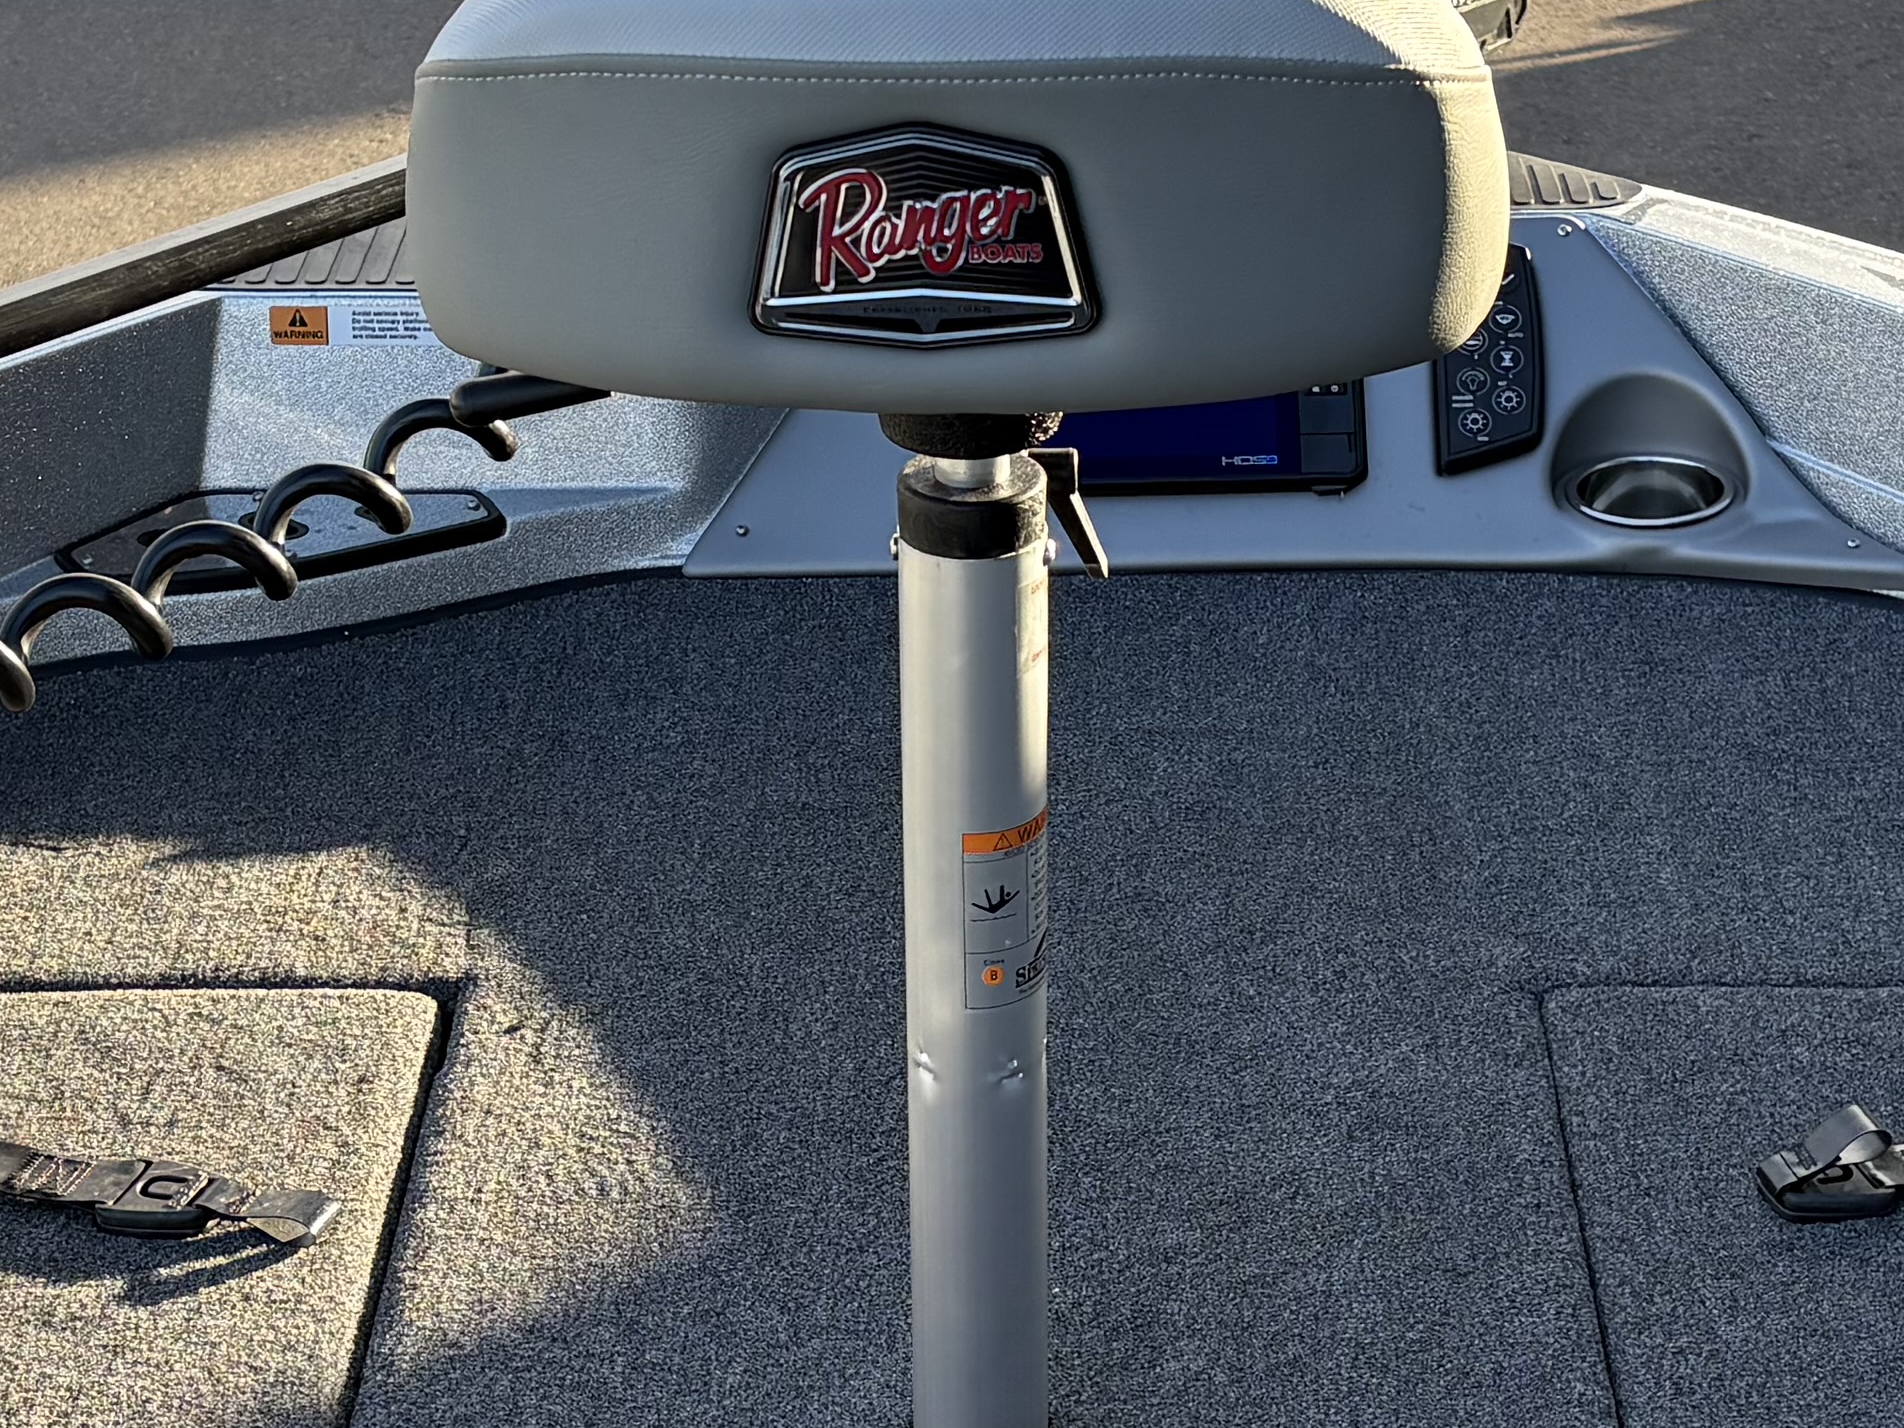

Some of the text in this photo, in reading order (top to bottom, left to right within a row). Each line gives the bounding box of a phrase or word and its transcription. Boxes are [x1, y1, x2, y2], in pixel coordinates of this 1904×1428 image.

[798, 168, 1036, 293] Ranger
[968, 243, 1044, 264] BOATS
[273, 330, 324, 340] WARNING
[990, 969, 998, 981] B
